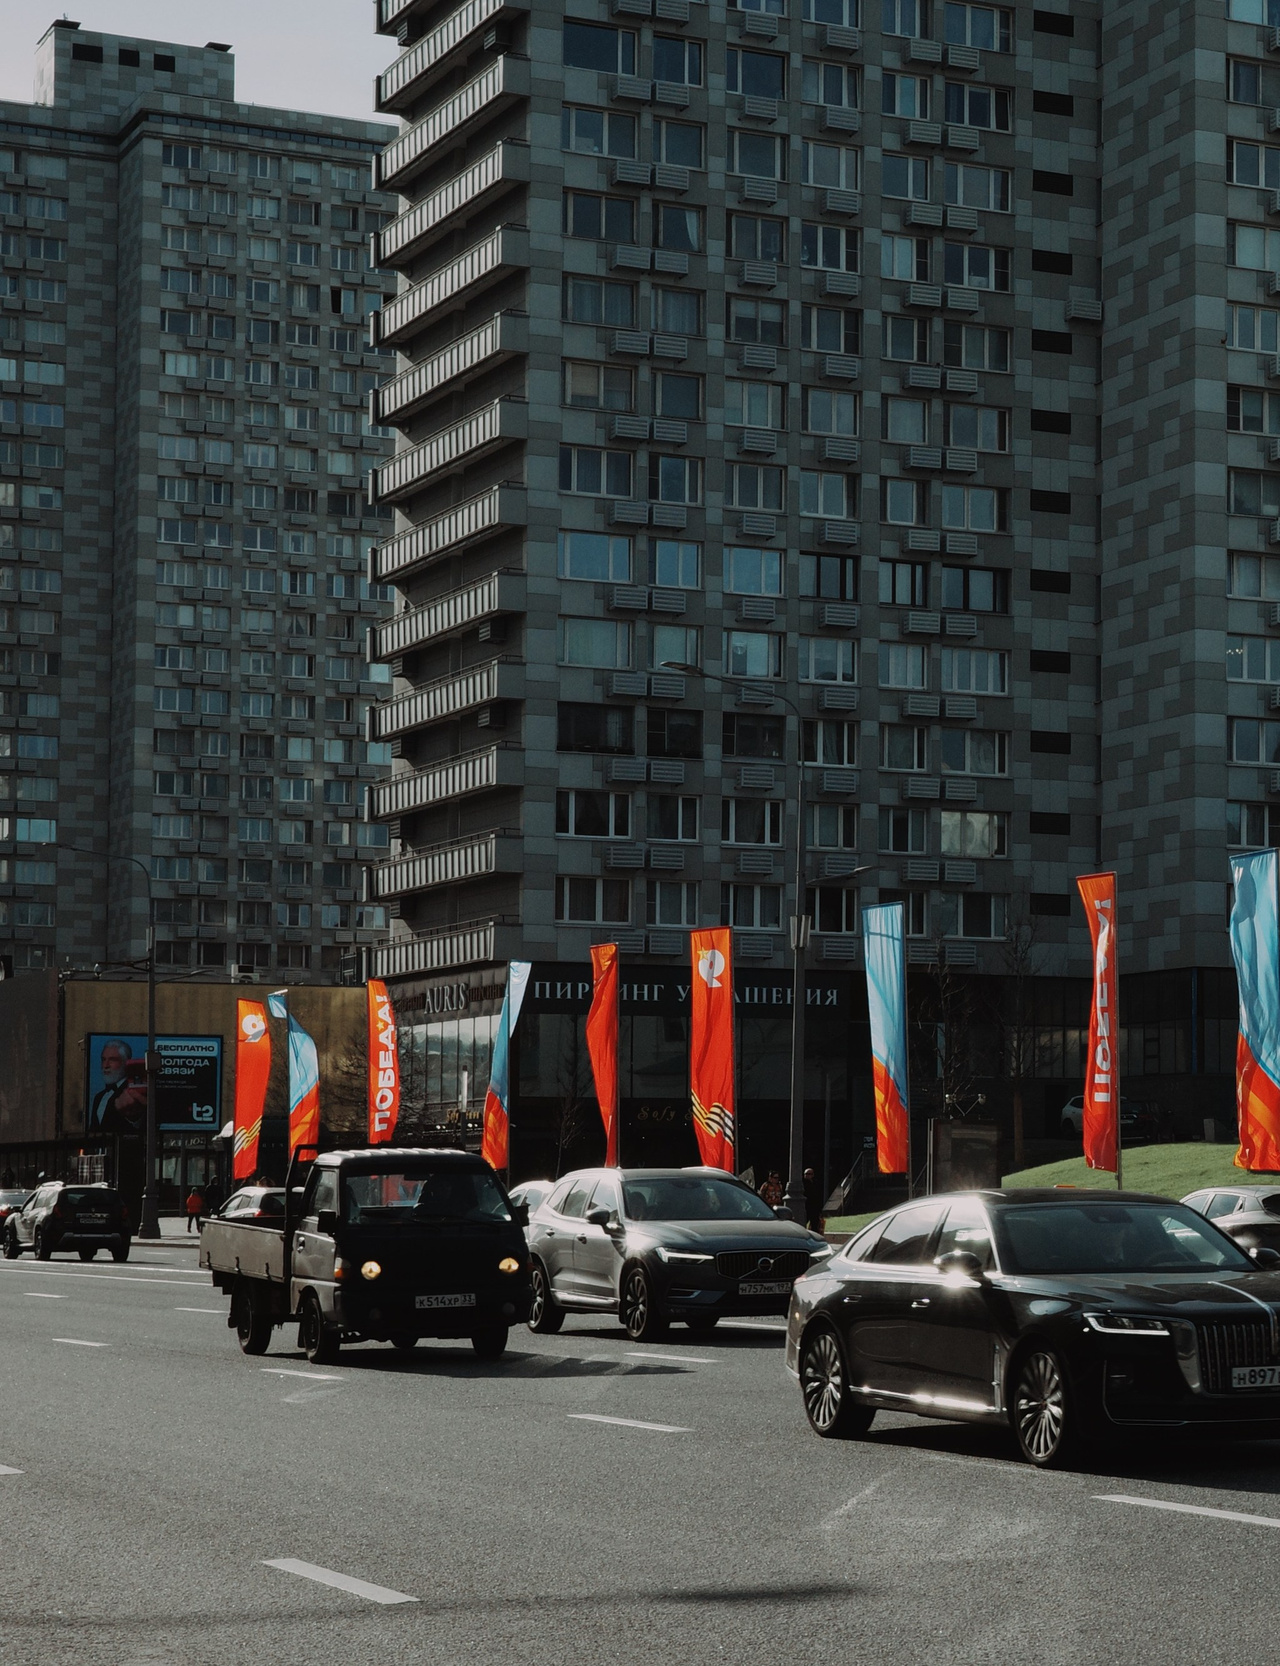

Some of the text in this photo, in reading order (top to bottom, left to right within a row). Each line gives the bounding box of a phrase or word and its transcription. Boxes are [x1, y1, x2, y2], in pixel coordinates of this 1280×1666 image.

[424, 982, 467, 1014] AURIS
[534, 981, 665, 1002] ПИРИНГ
[157, 1044, 215, 1052] БЕСПЛАТНО
[374, 994, 395, 1132] ПОБЕДА!
[192, 1102, 214, 1122] t2
